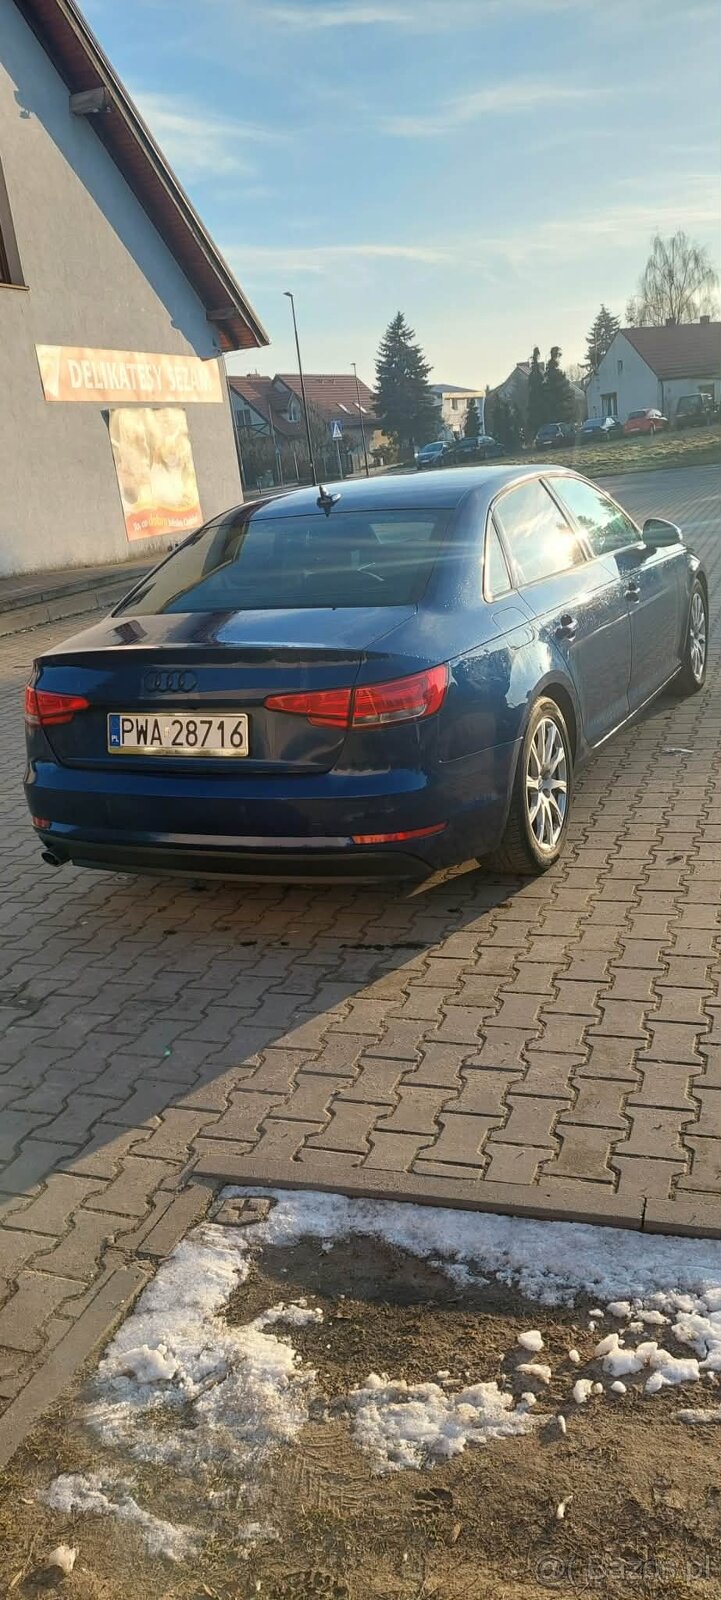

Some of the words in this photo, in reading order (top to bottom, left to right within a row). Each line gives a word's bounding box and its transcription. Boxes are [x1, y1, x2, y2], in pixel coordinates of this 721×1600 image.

[68, 359, 162, 391] DELIKATESY
[111, 735, 119, 743] PL
[121, 718, 163, 745] PWA
[171, 719, 244, 748] 28716
